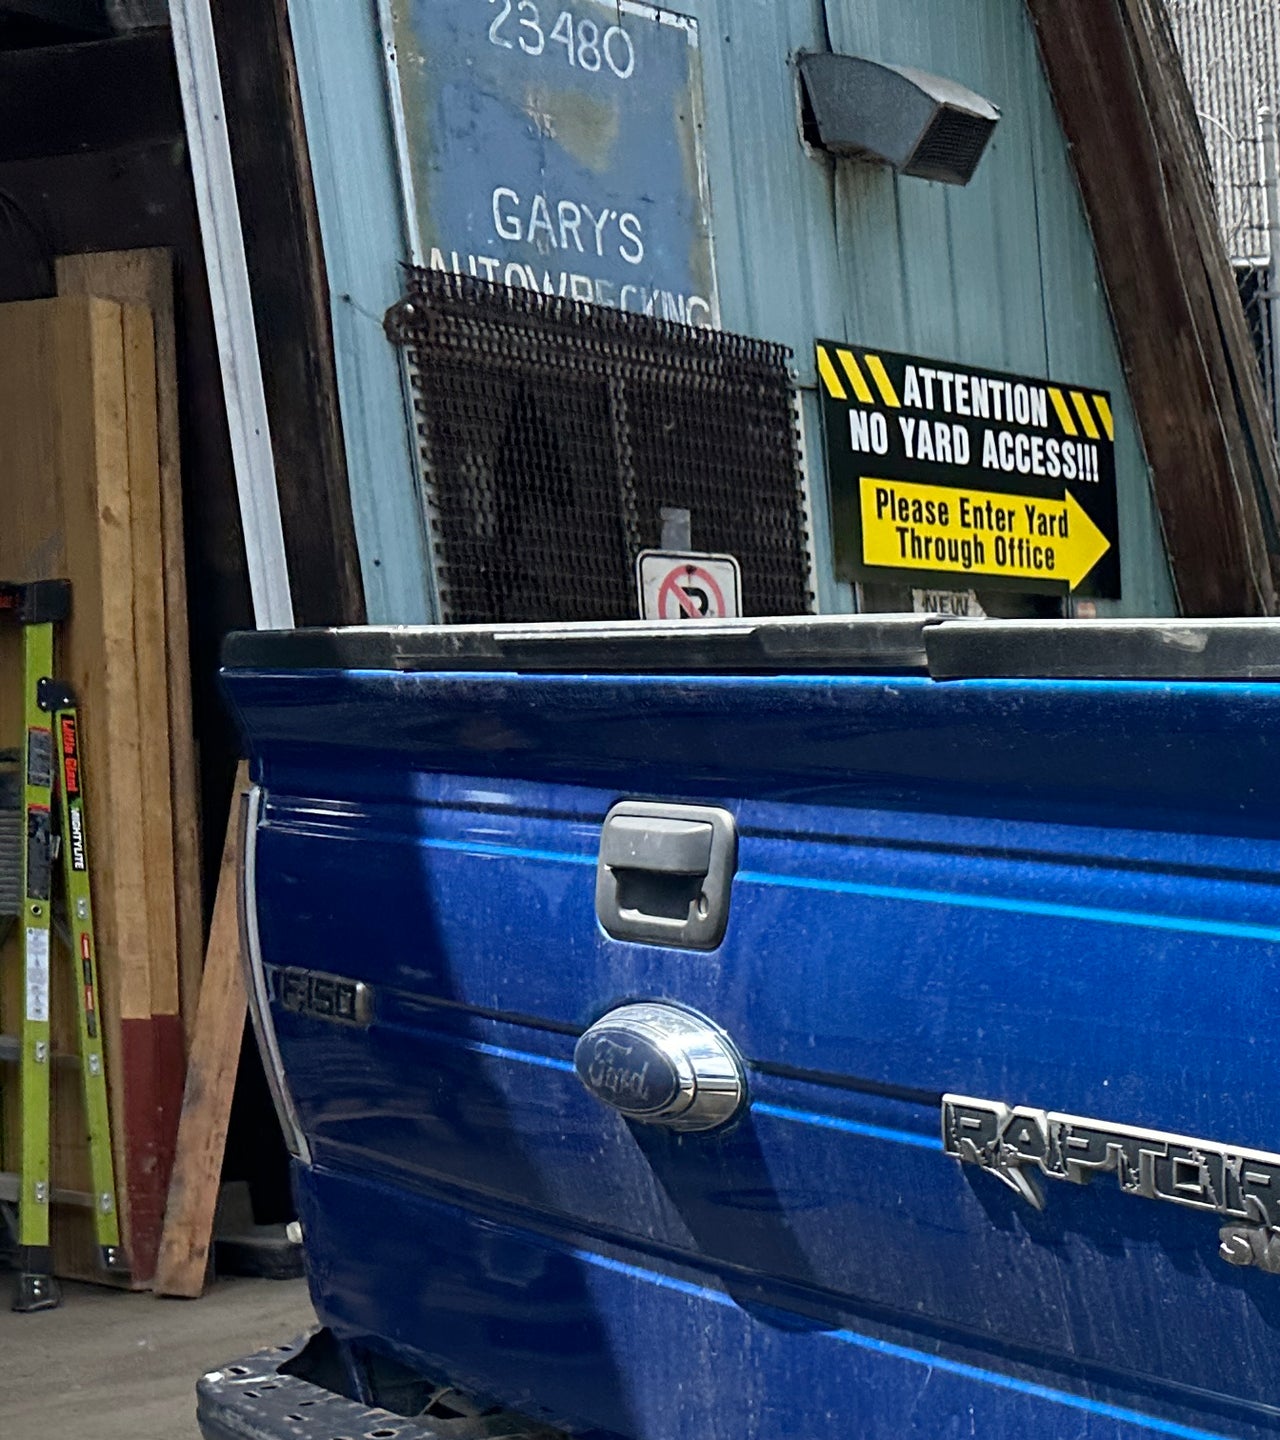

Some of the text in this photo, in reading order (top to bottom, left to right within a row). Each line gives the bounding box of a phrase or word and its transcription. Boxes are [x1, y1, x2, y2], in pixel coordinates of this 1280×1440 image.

[488, 0, 634, 78] 23480
[492, 187, 644, 265] GARY'S
[904, 365, 1048, 428] ATTENTION
[849, 409, 1099, 483] NO YARD ACCESS!!!
[875, 487, 1069, 539] Please Enter Yard
[896, 526, 1055, 570] Through Office
[588, 1037, 650, 1100] Ford
